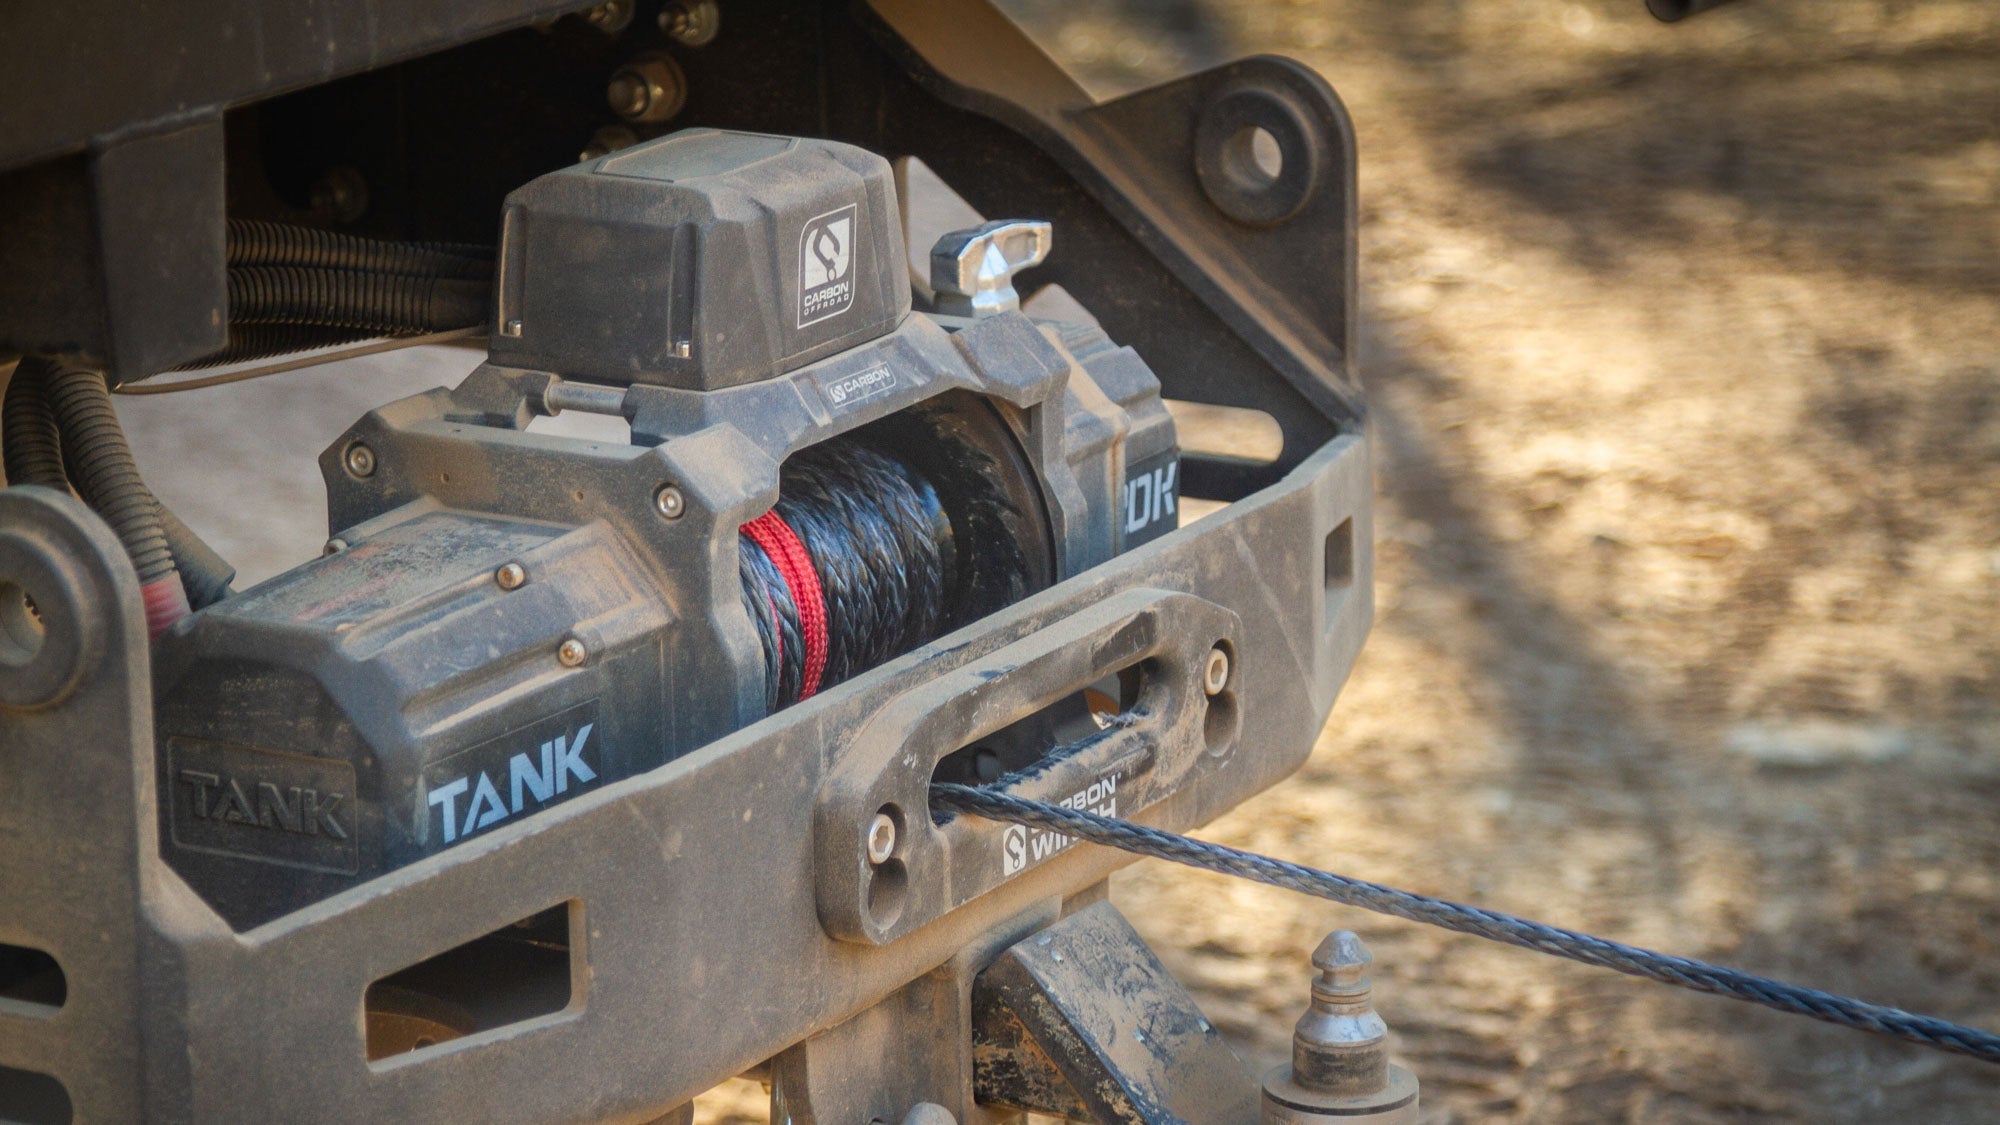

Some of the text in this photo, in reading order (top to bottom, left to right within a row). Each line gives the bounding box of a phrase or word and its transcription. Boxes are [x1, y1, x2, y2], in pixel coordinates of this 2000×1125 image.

[804, 293, 850, 316] OFFROAD
[805, 281, 849, 307] CARBON
[844, 367, 890, 392] CARBON
[178, 768, 348, 840] TANK
[428, 722, 598, 845] TANK
[1031, 797, 1116, 861] WIH
